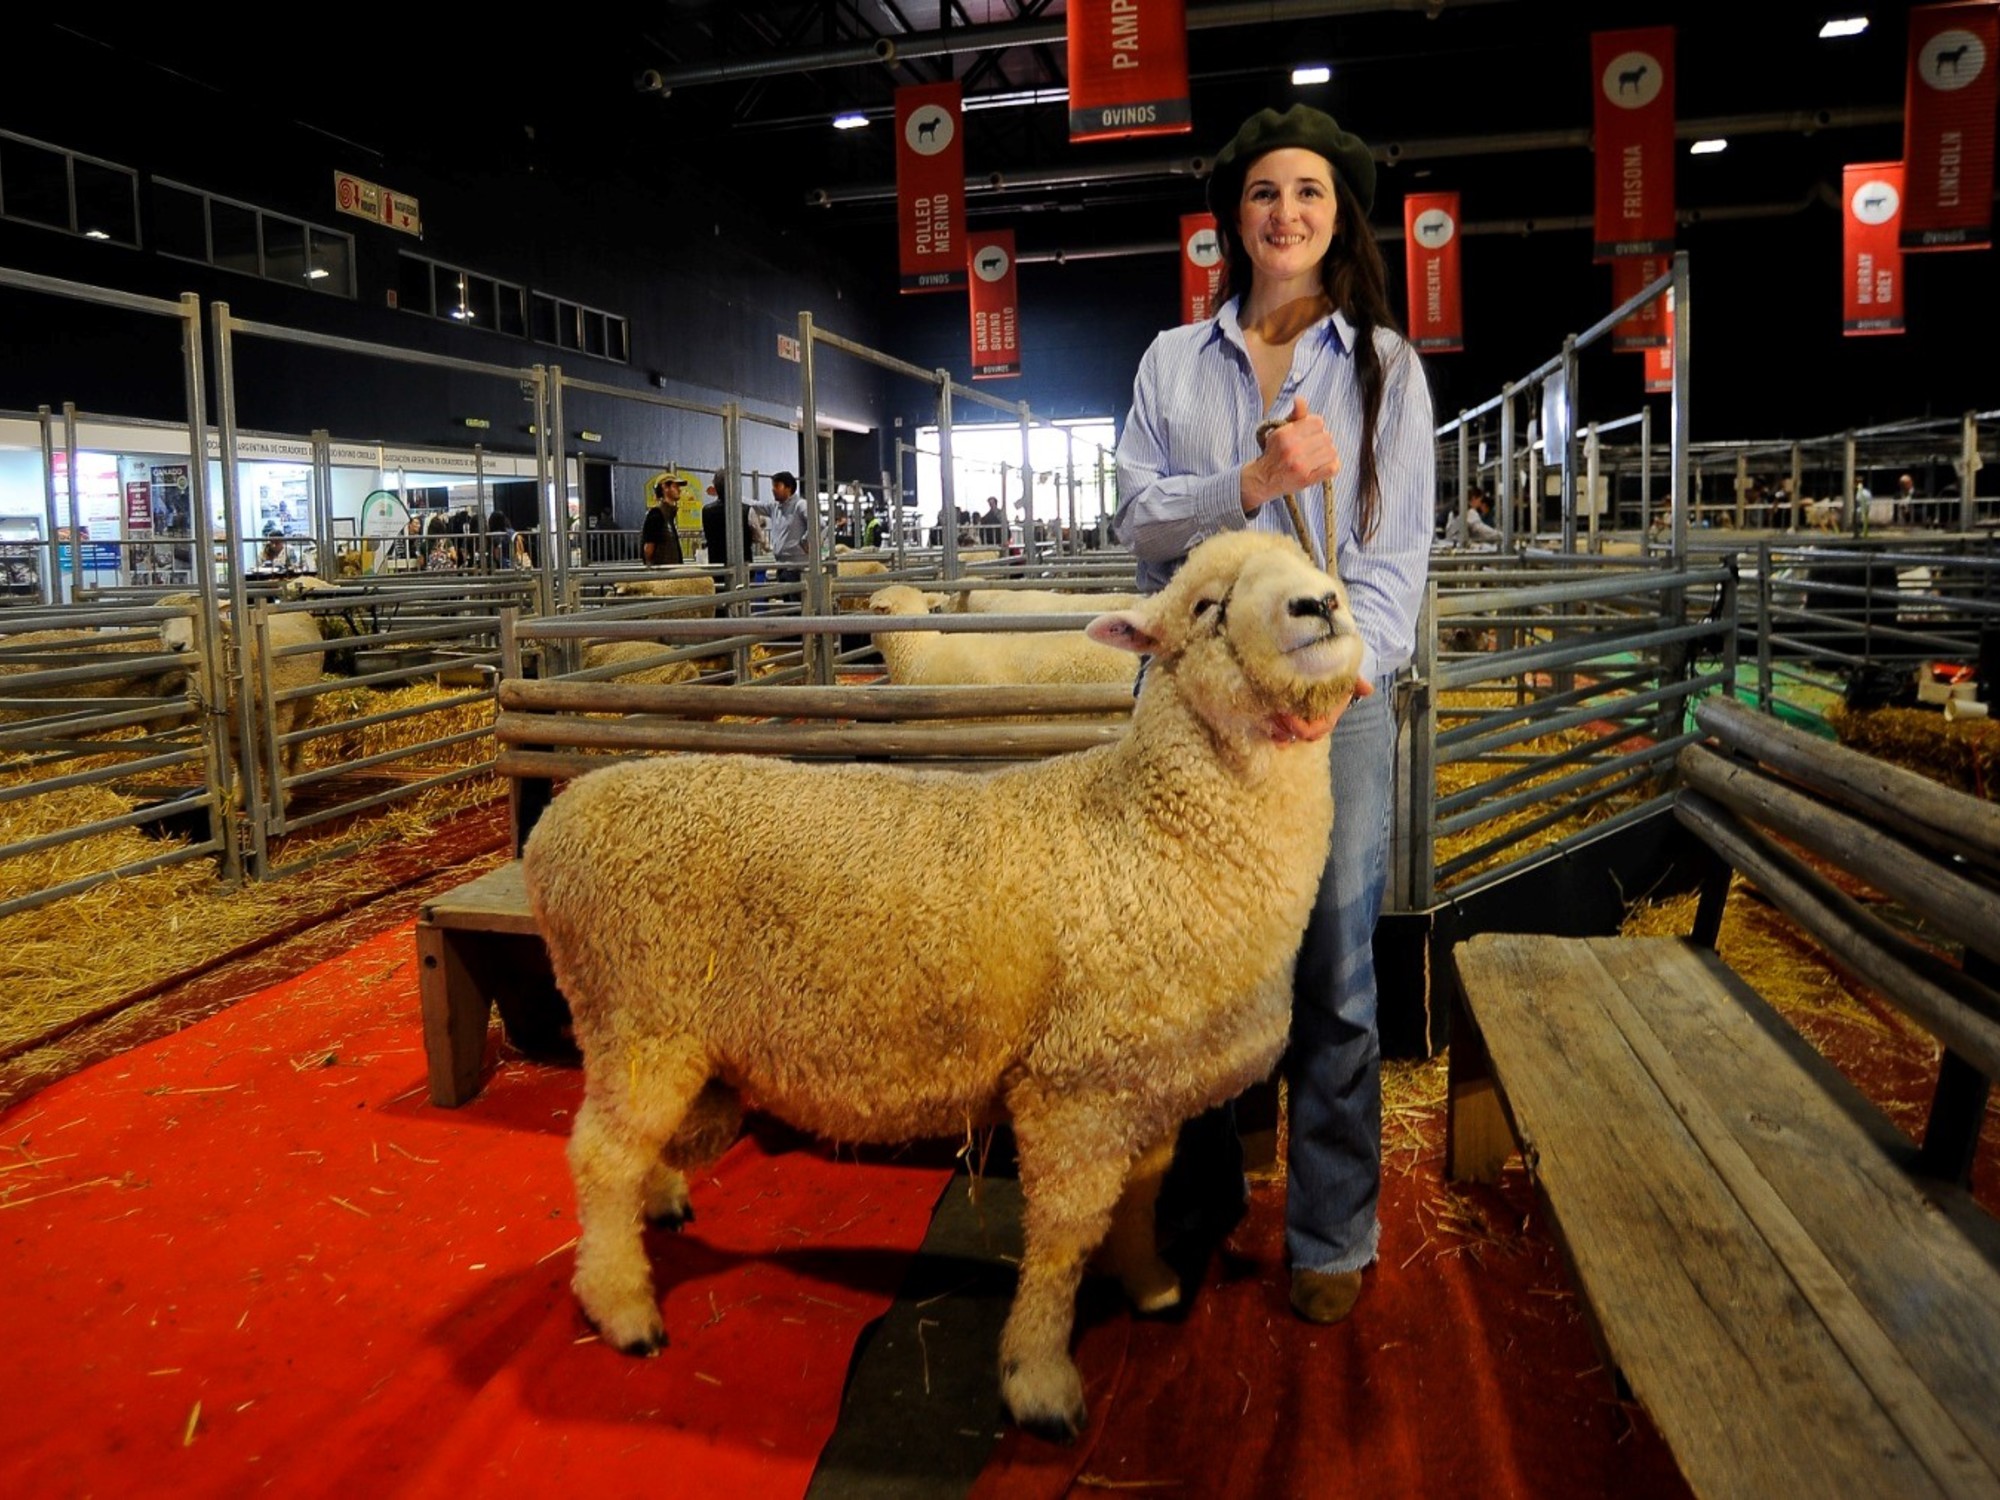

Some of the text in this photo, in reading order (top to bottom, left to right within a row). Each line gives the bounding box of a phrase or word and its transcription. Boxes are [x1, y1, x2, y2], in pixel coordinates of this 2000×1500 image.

[1112, 0, 1138, 69] PAMP
[1103, 106, 1156, 126] OVINOS
[1624, 145, 1642, 218] FRISONA
[1939, 132, 1961, 207] LINCOLN
[915, 198, 931, 254] POLLED
[934, 194, 950, 253] MERINO
[918, 274, 950, 286] OVINOS
[976, 311, 988, 352] GANADO
[990, 313, 1001, 351] BOVINO
[1003, 307, 1015, 350] CRIOLLO
